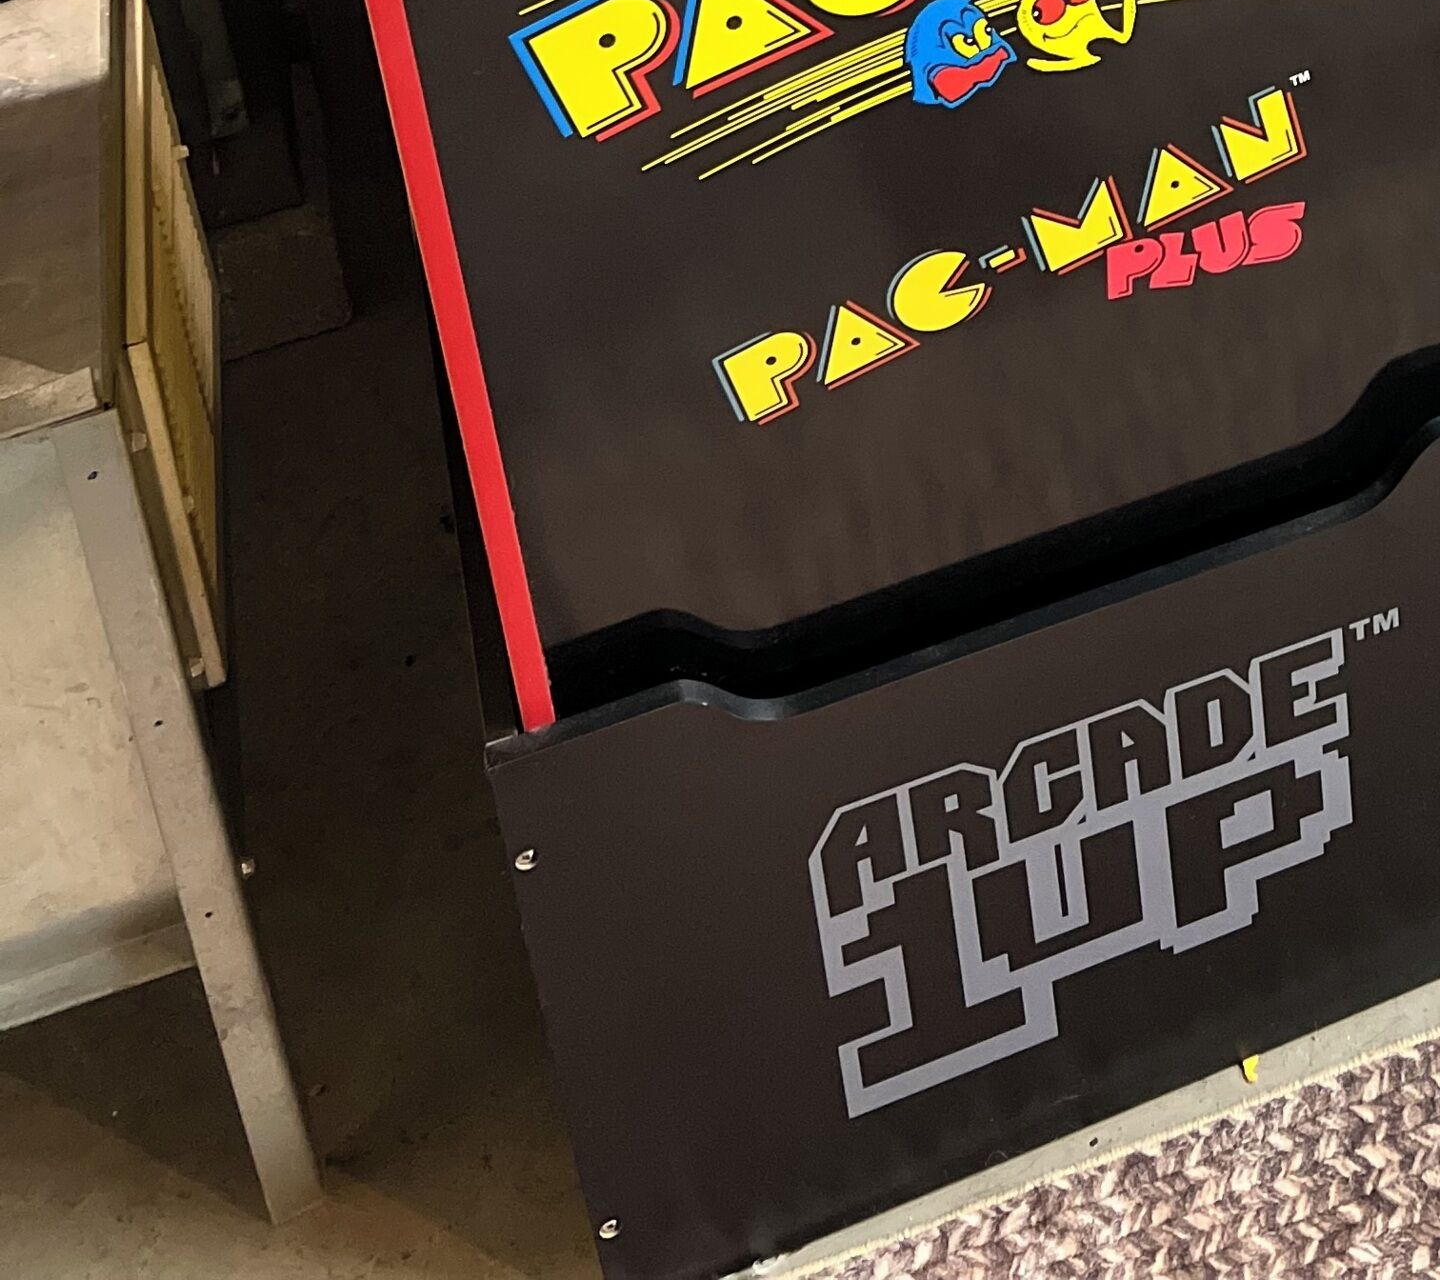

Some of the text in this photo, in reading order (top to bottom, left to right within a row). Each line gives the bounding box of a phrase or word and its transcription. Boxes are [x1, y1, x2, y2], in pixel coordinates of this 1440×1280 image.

[712, 87, 1307, 426] PAC-MAN
[1106, 200, 1305, 301] PLUS
[808, 628, 1350, 922] ARCADE
[832, 755, 1352, 1120] 1UP
